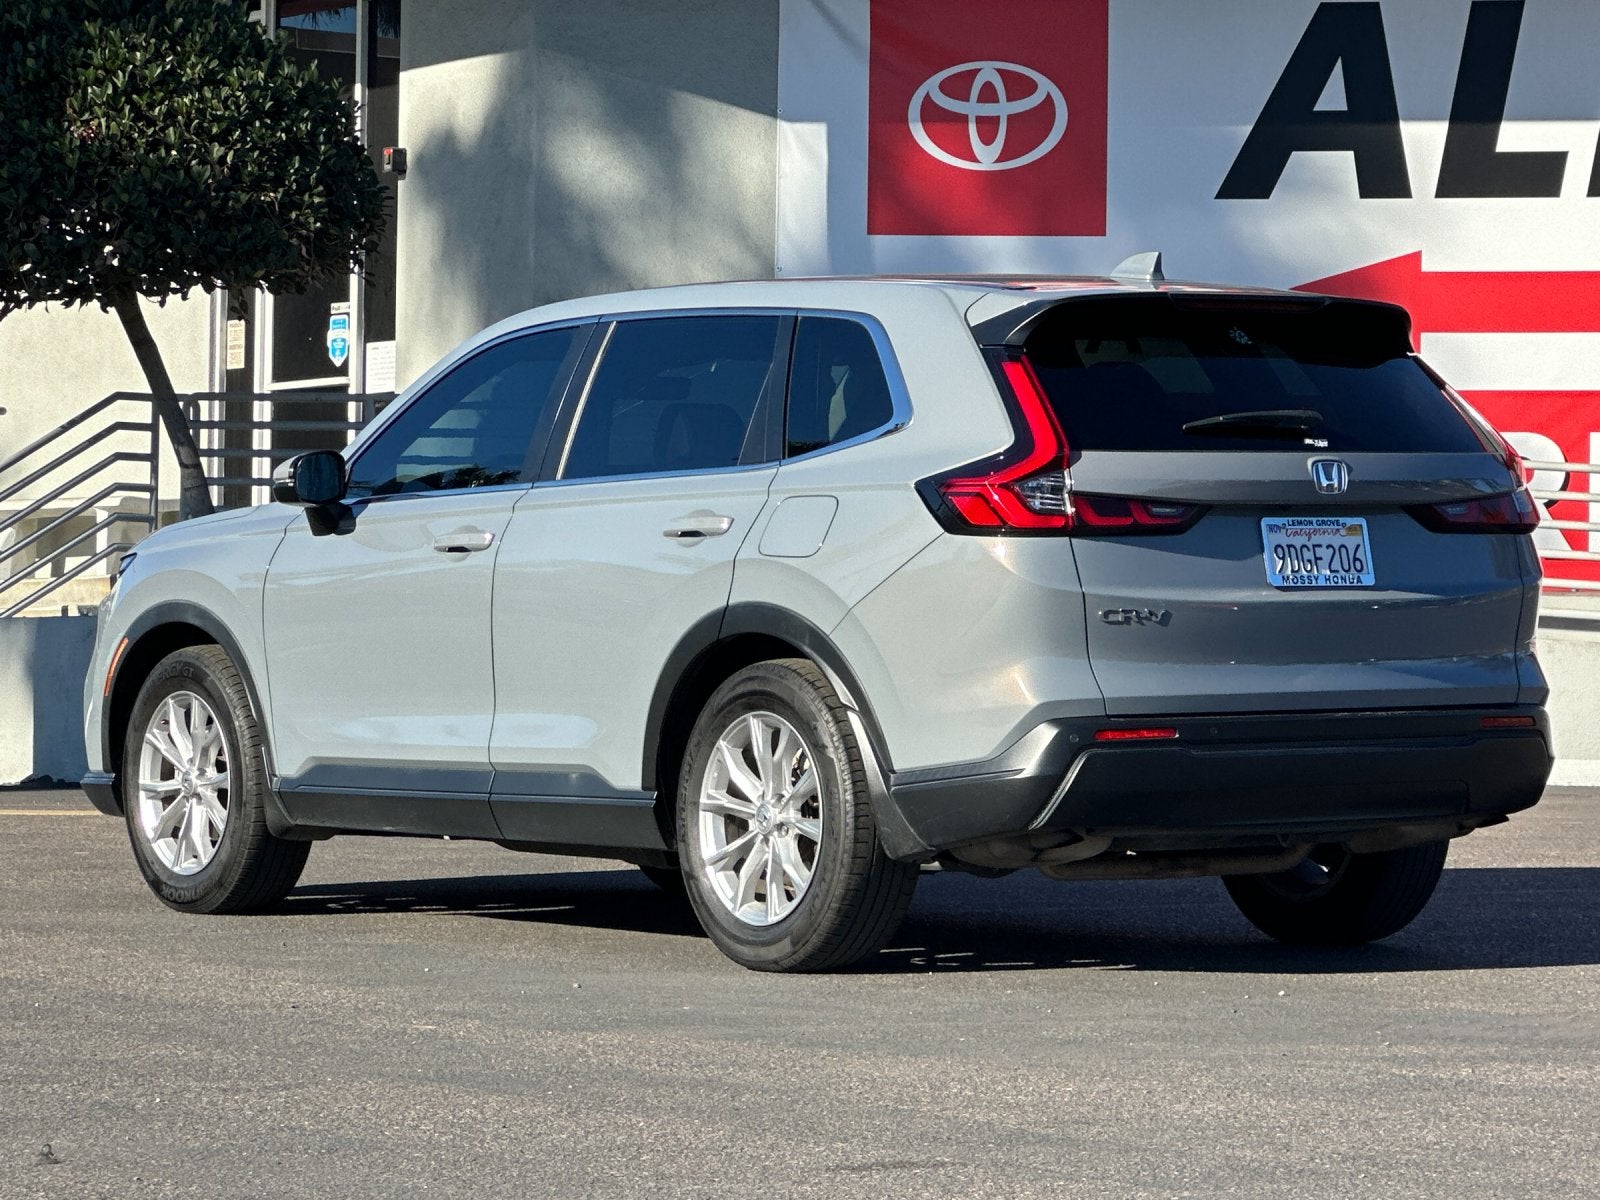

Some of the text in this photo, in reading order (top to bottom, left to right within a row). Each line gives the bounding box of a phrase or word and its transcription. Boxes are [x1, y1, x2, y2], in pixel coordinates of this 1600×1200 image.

[1287, 518, 1342, 527] LEMON GROVE
[1285, 527, 1343, 542] California
[1273, 543, 1364, 574] 9DGF206
[1281, 575, 1320, 585] MOSSY
